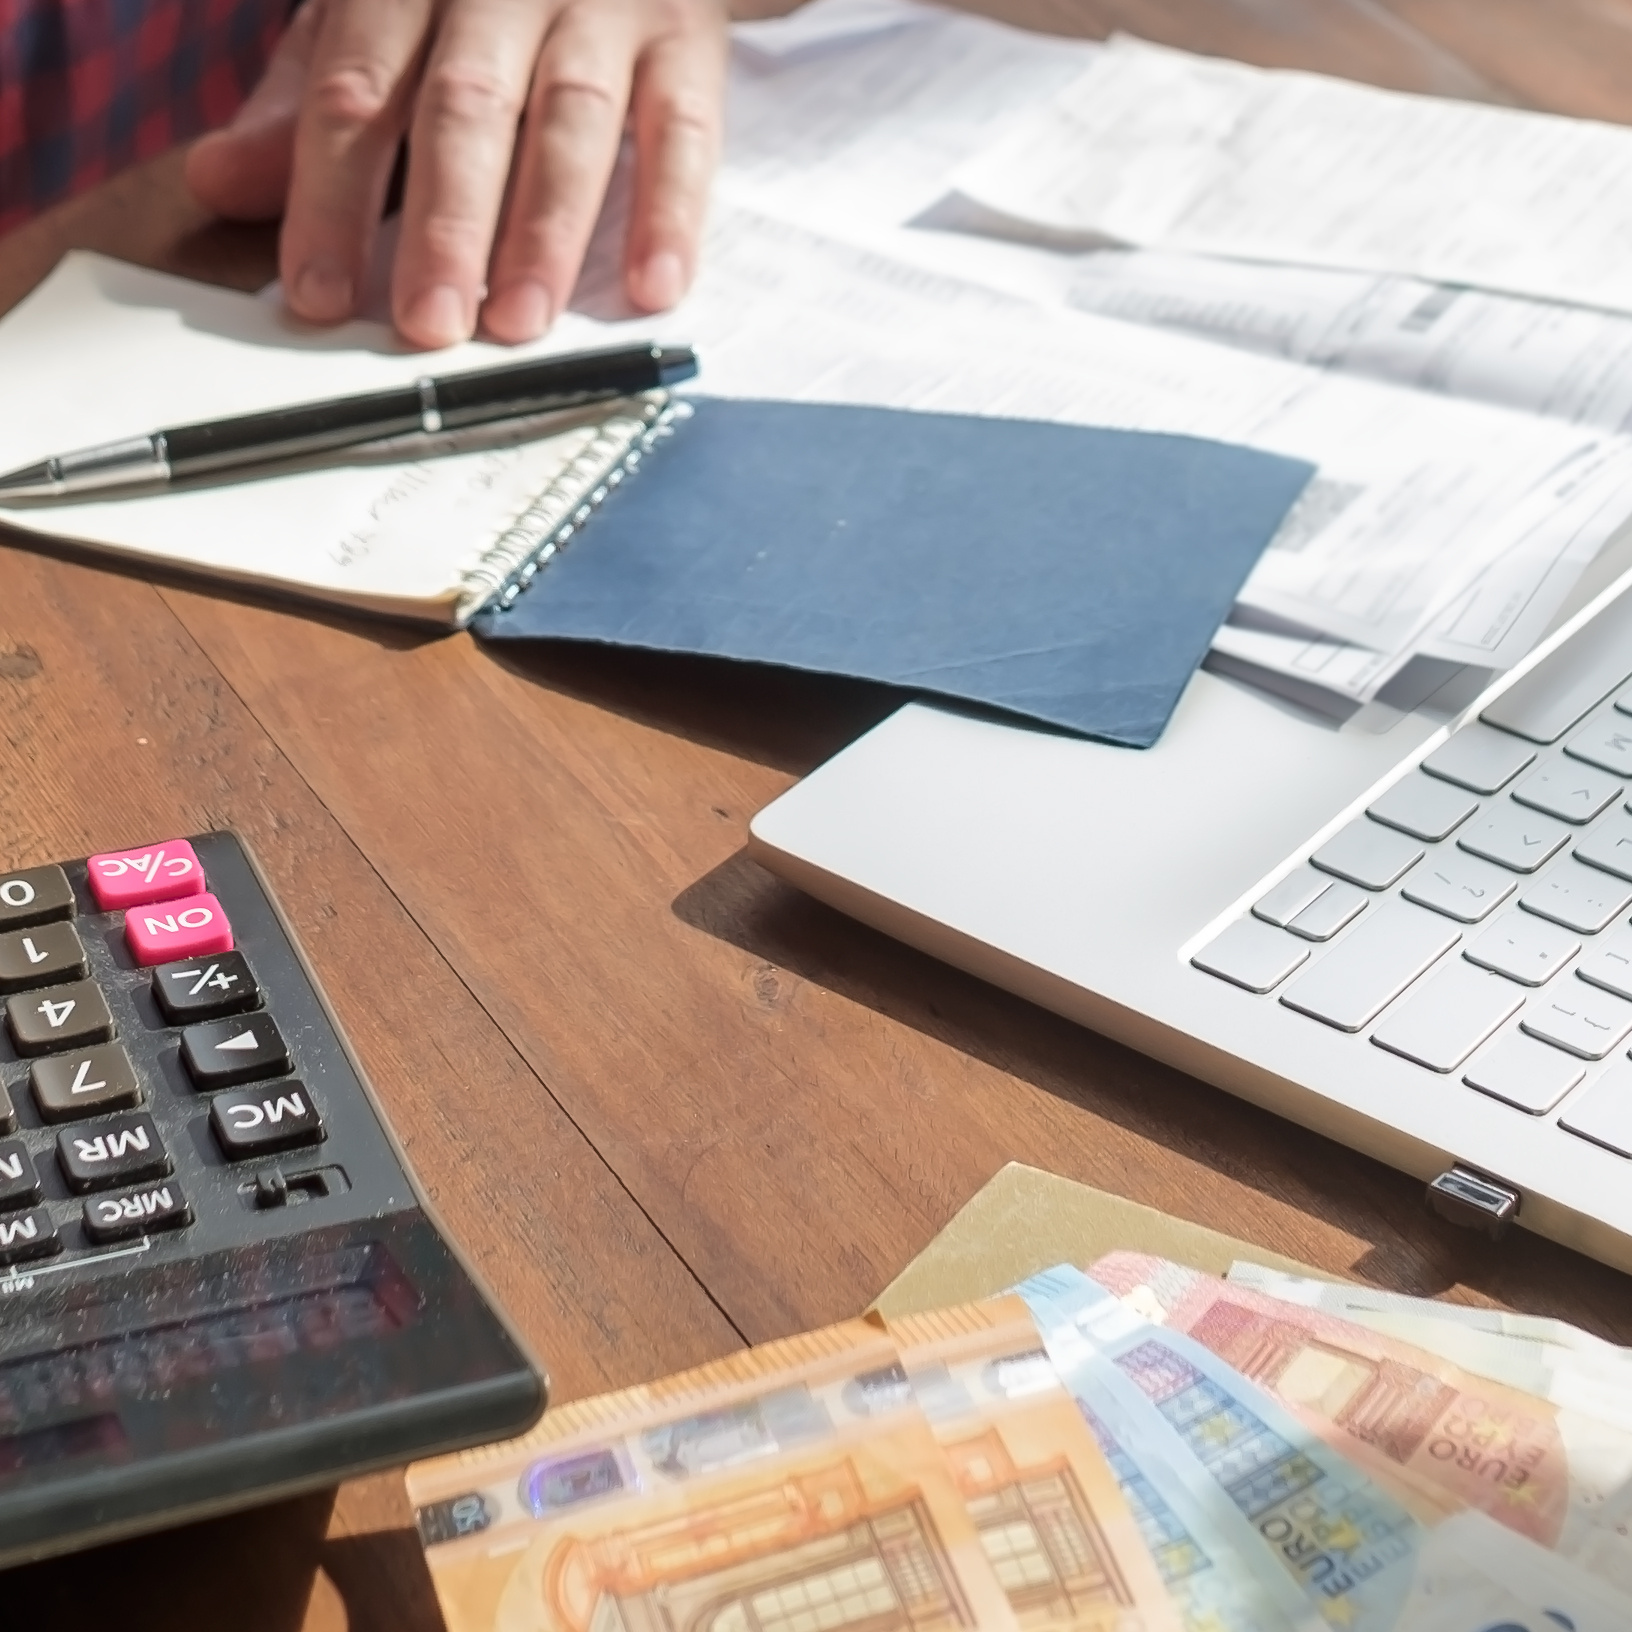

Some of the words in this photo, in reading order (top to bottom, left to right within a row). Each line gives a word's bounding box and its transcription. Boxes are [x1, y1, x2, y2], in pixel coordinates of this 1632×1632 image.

[98, 851, 192, 883] C/AC
[0, 881, 34, 905] 0
[144, 908, 212, 935] ON
[23, 938, 48, 963] 1
[38, 1000, 75, 1027] 4
[72, 1061, 106, 1094] 7
[227, 1093, 305, 1129] MC
[73, 1126, 149, 1162] MR
[96, 1188, 173, 1223] MRC
[1428, 1439, 1530, 1490] EURO
[1259, 1517, 1356, 1599] EURO
